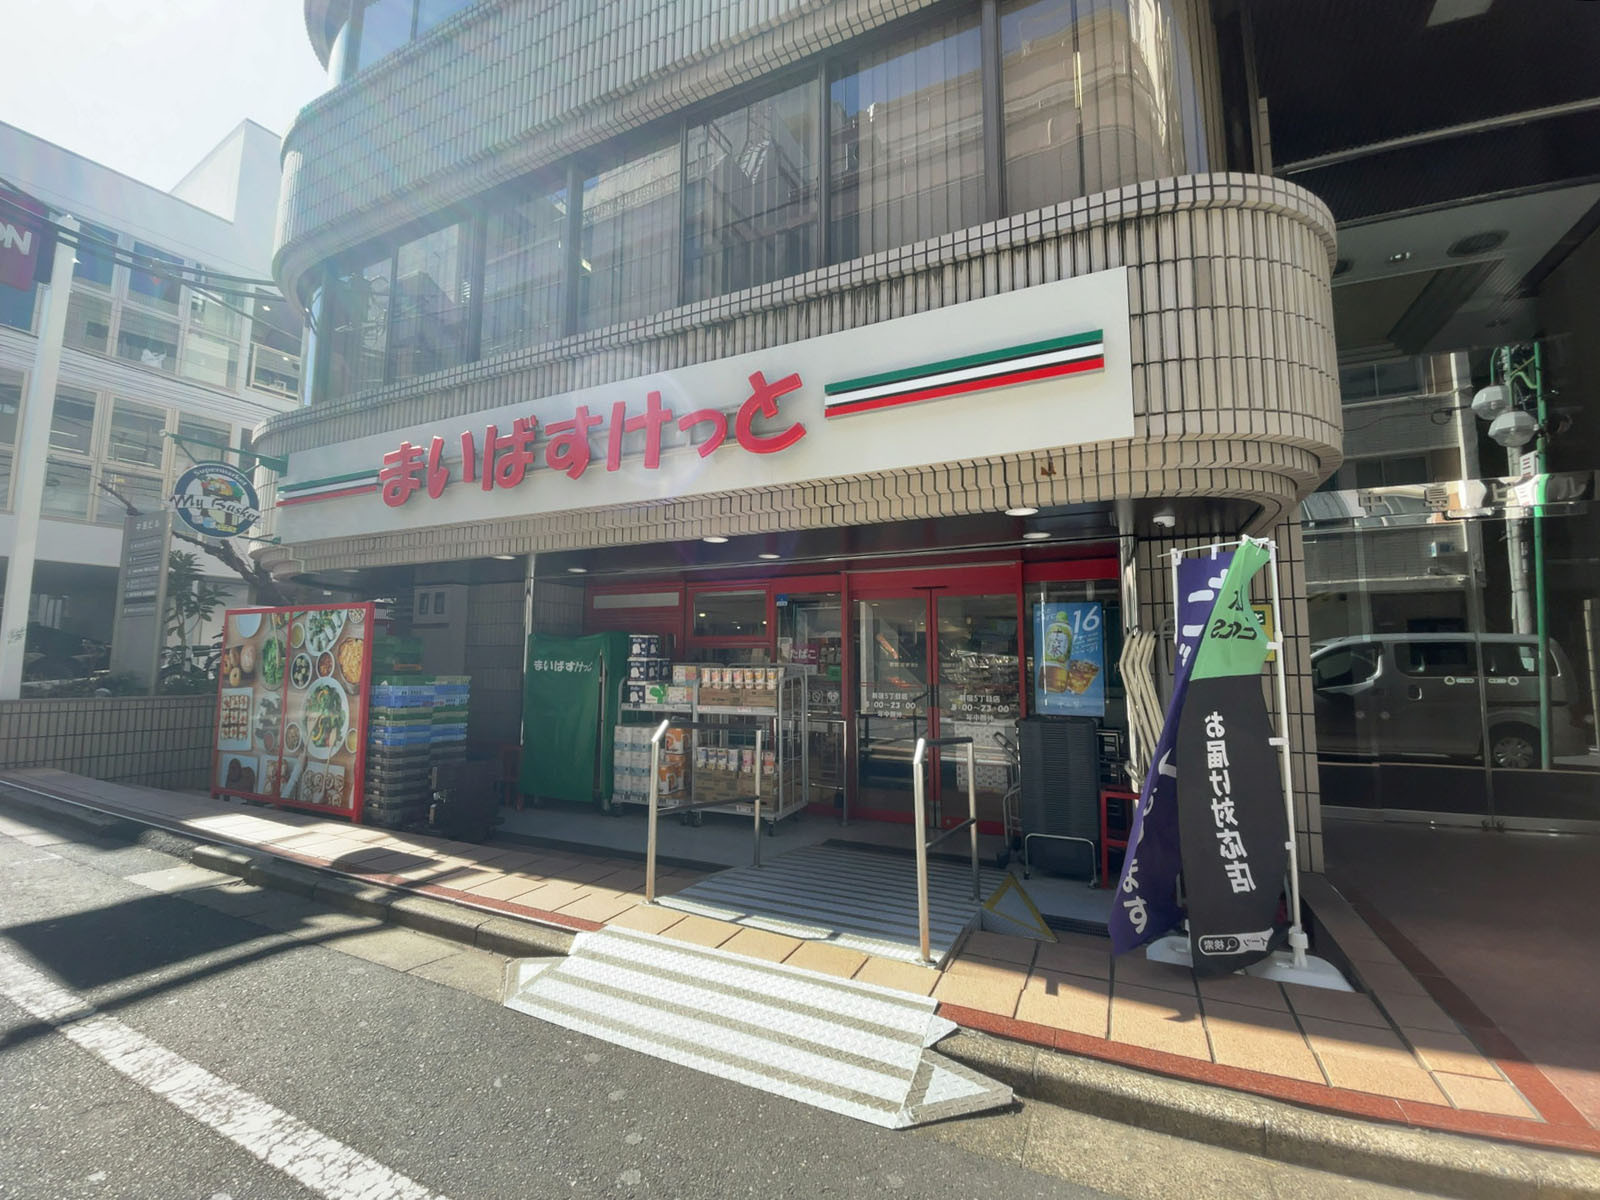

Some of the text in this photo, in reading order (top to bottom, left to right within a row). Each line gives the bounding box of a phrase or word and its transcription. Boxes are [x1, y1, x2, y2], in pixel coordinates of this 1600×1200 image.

[378, 370, 807, 508] まいばすけっと
[168, 494, 261, 522] My Basket
[1072, 604, 1100, 634] 16
